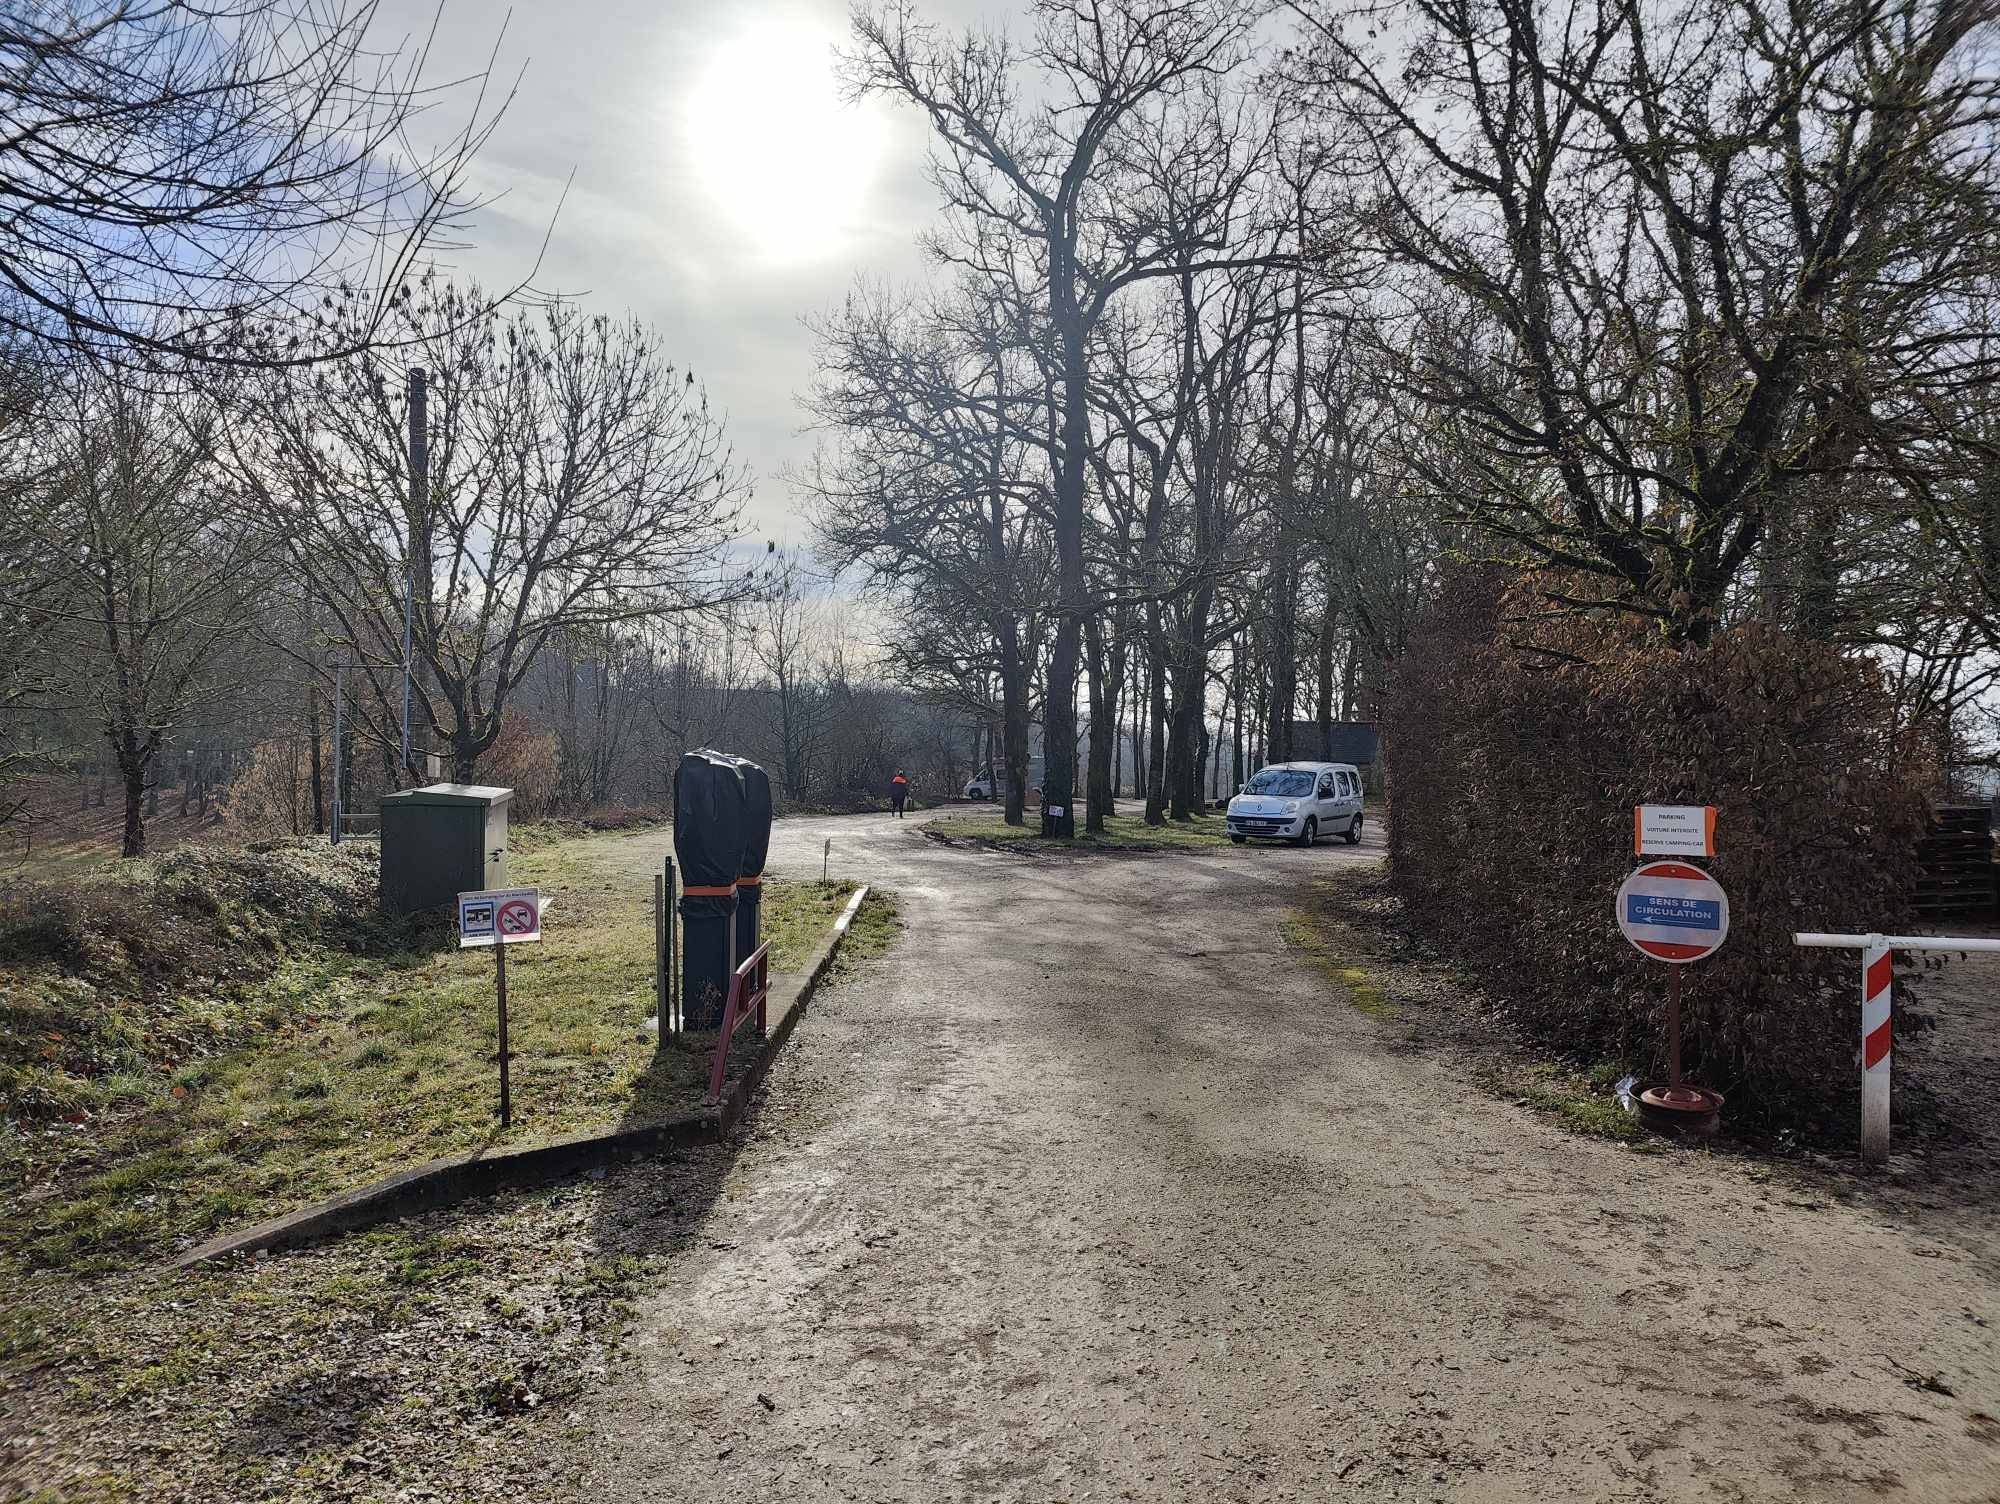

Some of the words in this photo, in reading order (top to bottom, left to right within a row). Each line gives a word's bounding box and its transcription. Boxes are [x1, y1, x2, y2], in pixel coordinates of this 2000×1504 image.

[1648, 897, 1679, 907] SENS
[1682, 900, 1697, 908] DE
[1634, 906, 1712, 919] CIRCULATION
